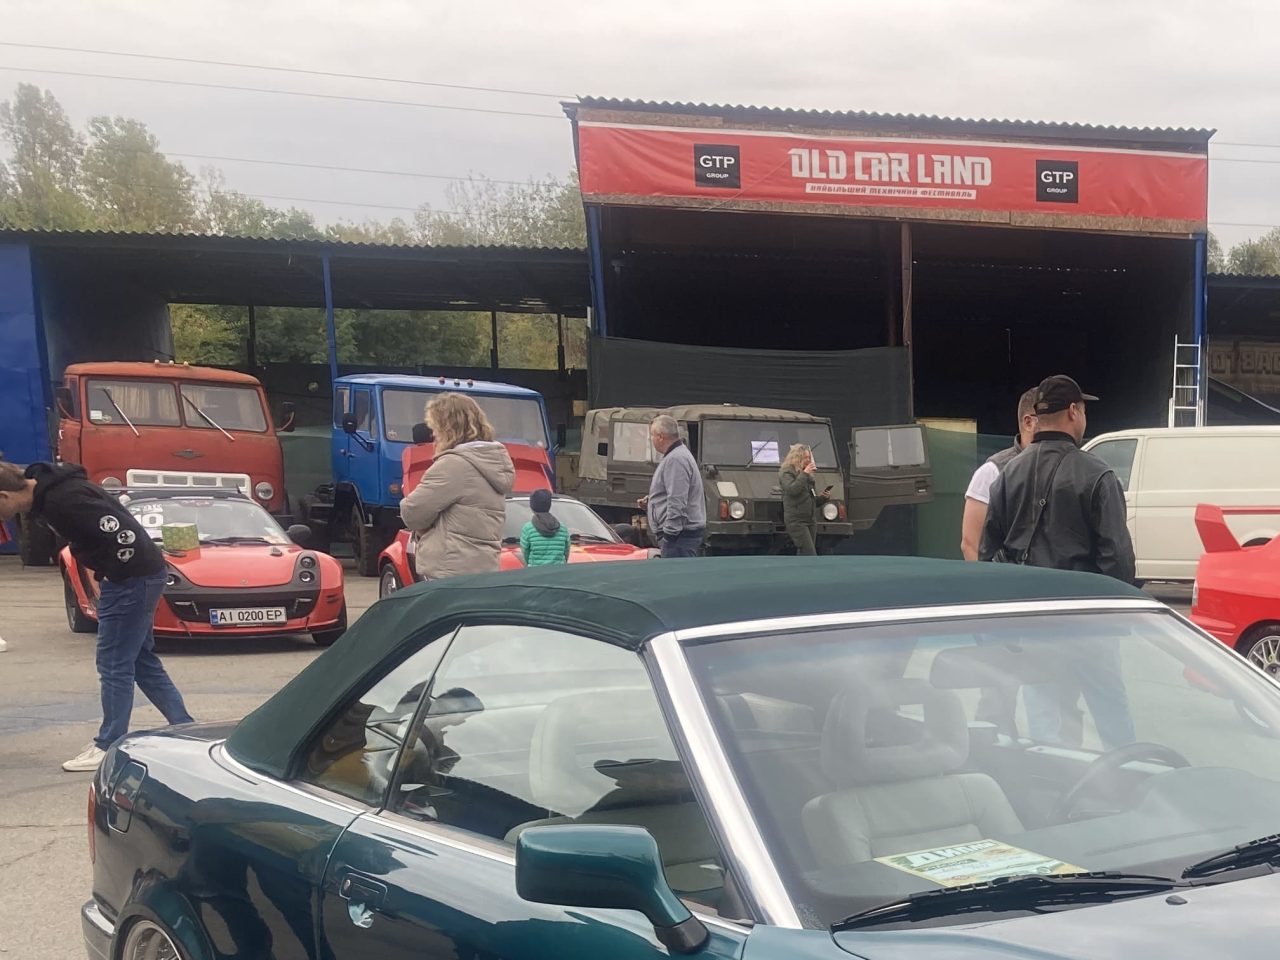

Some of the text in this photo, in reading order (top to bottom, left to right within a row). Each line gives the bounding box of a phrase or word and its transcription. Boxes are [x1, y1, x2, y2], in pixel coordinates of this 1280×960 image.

[699, 155, 735, 168] GTP
[788, 148, 992, 186] OLD CAR LAND
[1041, 171, 1074, 183] GTP
[237, 610, 264, 622] 0200
[266, 609, 282, 621] EP
